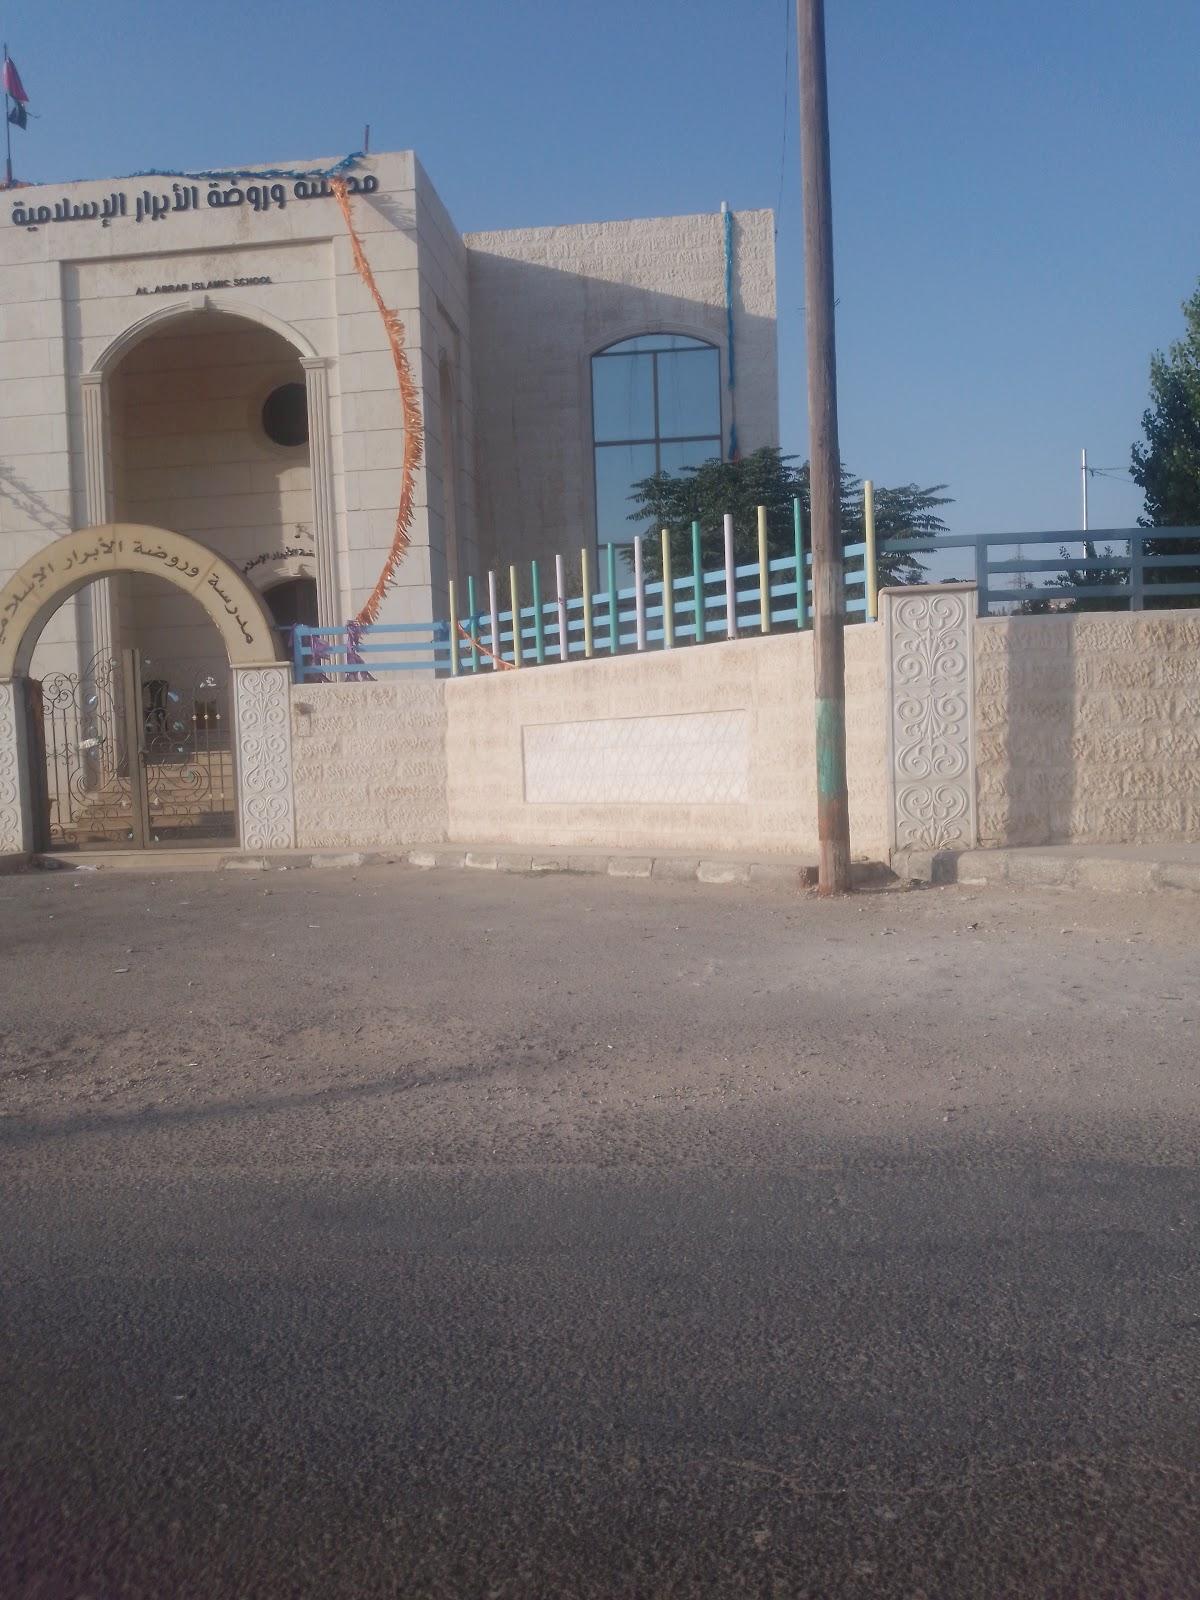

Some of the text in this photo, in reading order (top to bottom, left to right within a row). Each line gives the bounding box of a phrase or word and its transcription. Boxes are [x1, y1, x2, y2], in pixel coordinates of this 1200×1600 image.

[12, 192, 127, 232] الإسلامية
[135, 183, 200, 222] الأبرار
[207, 179, 287, 211] وروضة
[191, 279, 232, 291] ISLAMIC
[233, 276, 272, 287] SCHOOL
[133, 540, 199, 577] وروضة
[208, 572, 254, 644] مدرسة
